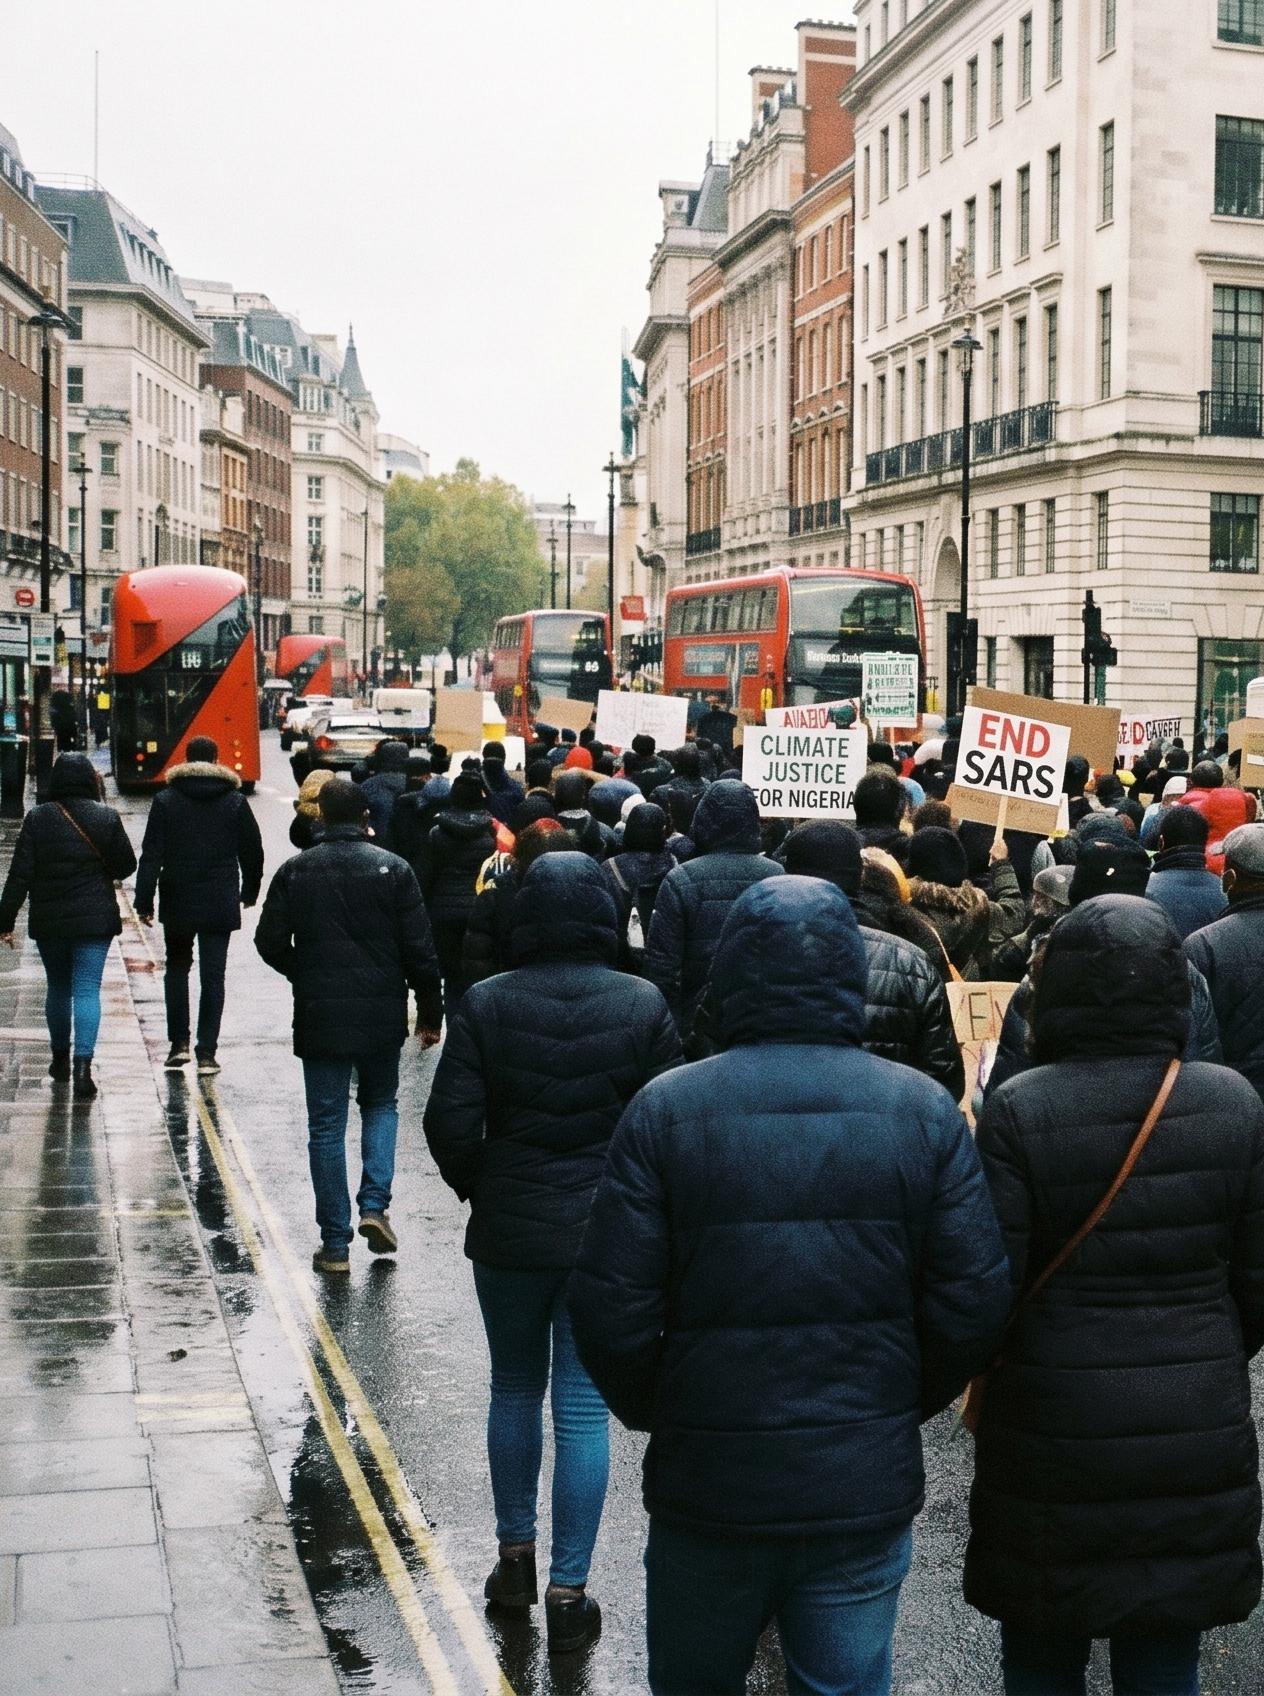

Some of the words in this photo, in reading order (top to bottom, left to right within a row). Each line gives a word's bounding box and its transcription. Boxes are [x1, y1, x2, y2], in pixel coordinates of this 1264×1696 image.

[760, 734, 850, 758] CLIMATE
[977, 713, 1051, 758] END
[762, 761, 847, 784] JUSTICE
[962, 750, 1056, 799] SARS
[788, 789, 856, 809] NIGERIA
